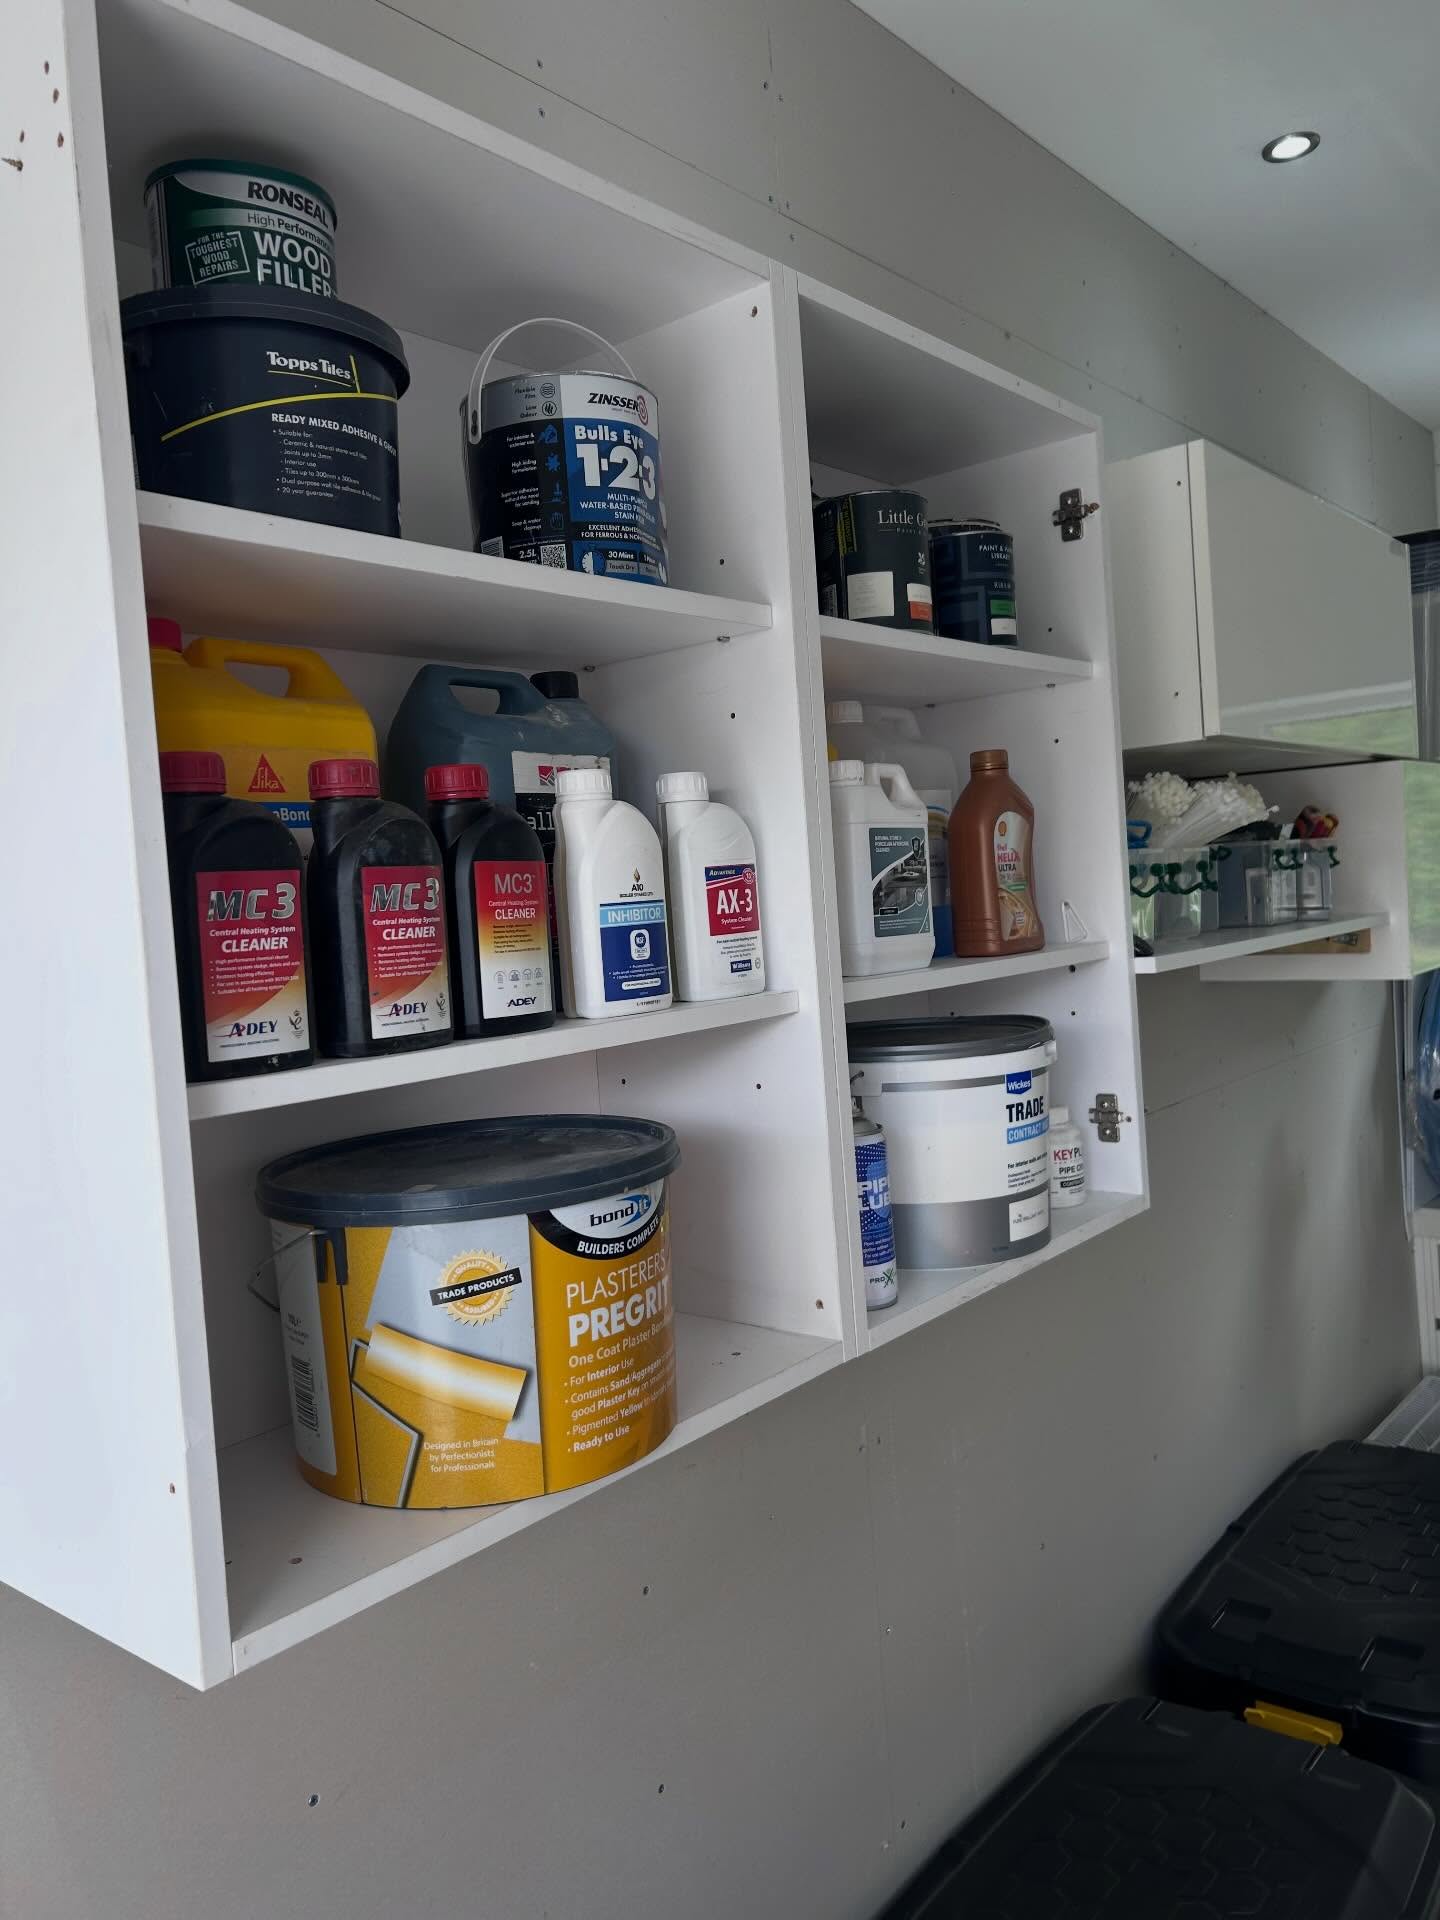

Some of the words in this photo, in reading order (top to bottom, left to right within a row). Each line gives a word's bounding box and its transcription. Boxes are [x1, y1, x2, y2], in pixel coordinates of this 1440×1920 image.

[248, 181, 329, 230] RONSEAL
[247, 211, 275, 227] High
[197, 235, 210, 244] FOR
[211, 231, 225, 240] THE
[190, 237, 238, 259] TOUGHEST
[253, 231, 331, 279] WOOD
[201, 250, 230, 265] WOOD
[200, 260, 239, 278] REPAIRS
[257, 258, 333, 298] FILLER
[267, 351, 319, 373] Topps
[318, 362, 351, 380] Tiles
[588, 392, 640, 412] ZINSSER
[271, 413, 306, 425] READY
[308, 417, 340, 431] MIXED
[341, 424, 378, 444] ADHESIVE
[575, 425, 618, 442] Bulls
[623, 429, 644, 450] Eye
[283, 439, 309, 447] Ceramic
[579, 501, 633, 511] WATER-BASED
[614, 511, 636, 520] STAIN
[878, 510, 914, 525] Little
[520, 549, 537, 559] 2.5L
[608, 551, 618, 559] 30
[618, 551, 634, 560] Mins
[252, 766, 279, 790] Sika
[494, 873, 533, 895] MC3
[632, 883, 644, 892] A10
[207, 882, 298, 922] MC3
[370, 877, 440, 913] MC3
[717, 888, 753, 915] AX-3
[372, 918, 397, 927] Central
[398, 917, 422, 926] Heating
[495, 907, 536, 920] CLEANER
[607, 907, 662, 923] INHIBITOR
[209, 928, 239, 937] Central
[240, 926, 269, 937] Heating
[270, 925, 296, 934] System
[382, 926, 436, 941] CLEANER
[221, 936, 289, 954] CLEANER
[389, 1000, 429, 1018] ADEY
[508, 997, 537, 1008] ADEY
[228, 1019, 278, 1039] ADEY
[1007, 1080, 1031, 1091] Wickes
[1006, 1095, 1044, 1123] TRADE
[1059, 1165, 1076, 1174] PIPE
[590, 1203, 635, 1227] bond
[577, 1240, 625, 1255] BUILDERS
[438, 1288, 467, 1300] TRADE
[468, 1274, 515, 1294] PRODUCTS
[567, 1249, 667, 1308] PLASTERERS
[568, 1276, 670, 1347] PREGRIT
[568, 1354, 594, 1368] One
[596, 1344, 621, 1360] Coat
[622, 1329, 651, 1351] Plaster
[570, 1375, 587, 1387] For
[587, 1363, 620, 1381] Interior
[621, 1358, 634, 1369] Use
[570, 1386, 609, 1403] Contains
[571, 1402, 596, 1421] good
[598, 1392, 626, 1410] Plaster
[628, 1386, 640, 1400] Key
[572, 1412, 619, 1435] Pigmented
[619, 1399, 643, 1419] Yellow
[423, 1440, 462, 1452] Designed
[463, 1440, 471, 1448] in
[472, 1438, 500, 1448] Britain
[573, 1435, 602, 1452] Ready
[605, 1431, 614, 1441] to
[615, 1425, 631, 1438] Use
[429, 1453, 439, 1463] by
[441, 1449, 496, 1461] Perfectionists
[431, 1464, 441, 1473] for
[443, 1460, 496, 1472] Professionals
